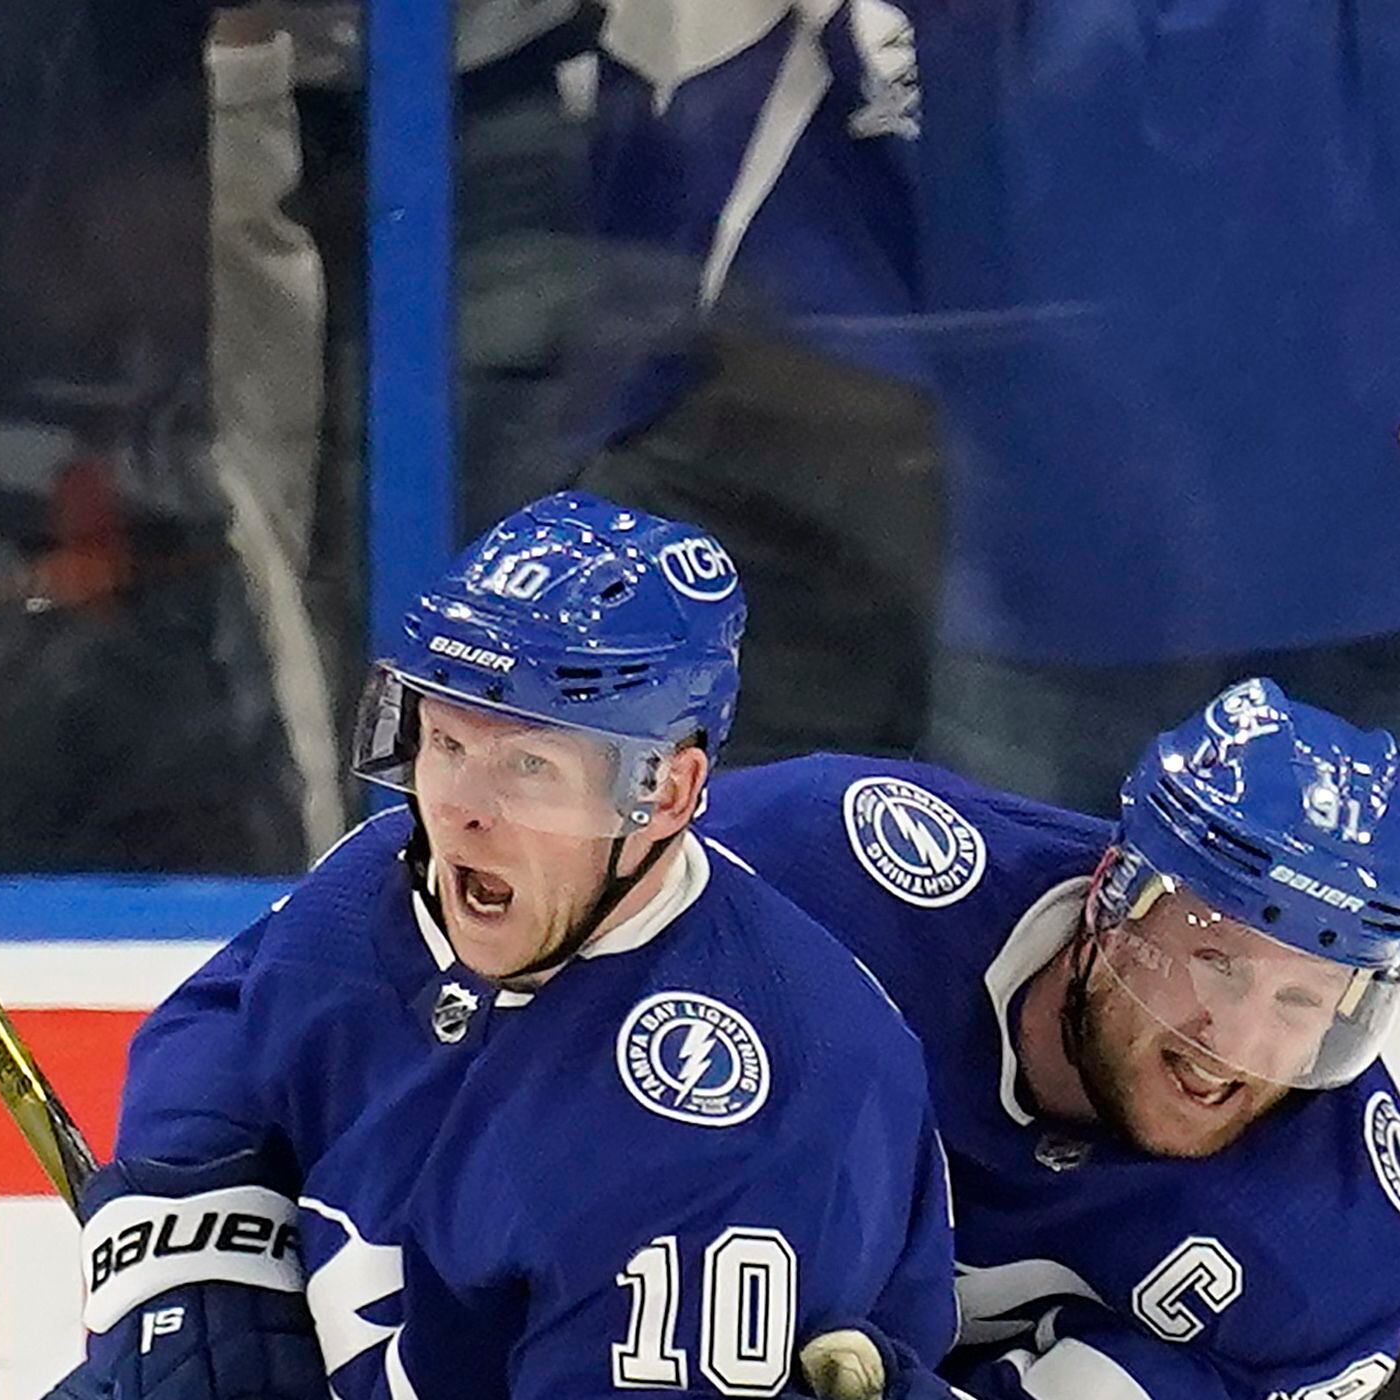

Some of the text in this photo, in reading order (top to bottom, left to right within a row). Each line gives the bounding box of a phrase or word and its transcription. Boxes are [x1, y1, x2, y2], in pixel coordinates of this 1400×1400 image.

[664, 535, 738, 585] TGH
[429, 636, 516, 673] BAUER
[866, 841, 971, 896] LIGHTNING
[1269, 864, 1365, 914] BAUER
[628, 1002, 760, 1101] TAMPA BAY LIGHTNING
[611, 1226, 797, 1399] 10
[1133, 1236, 1243, 1343] C
